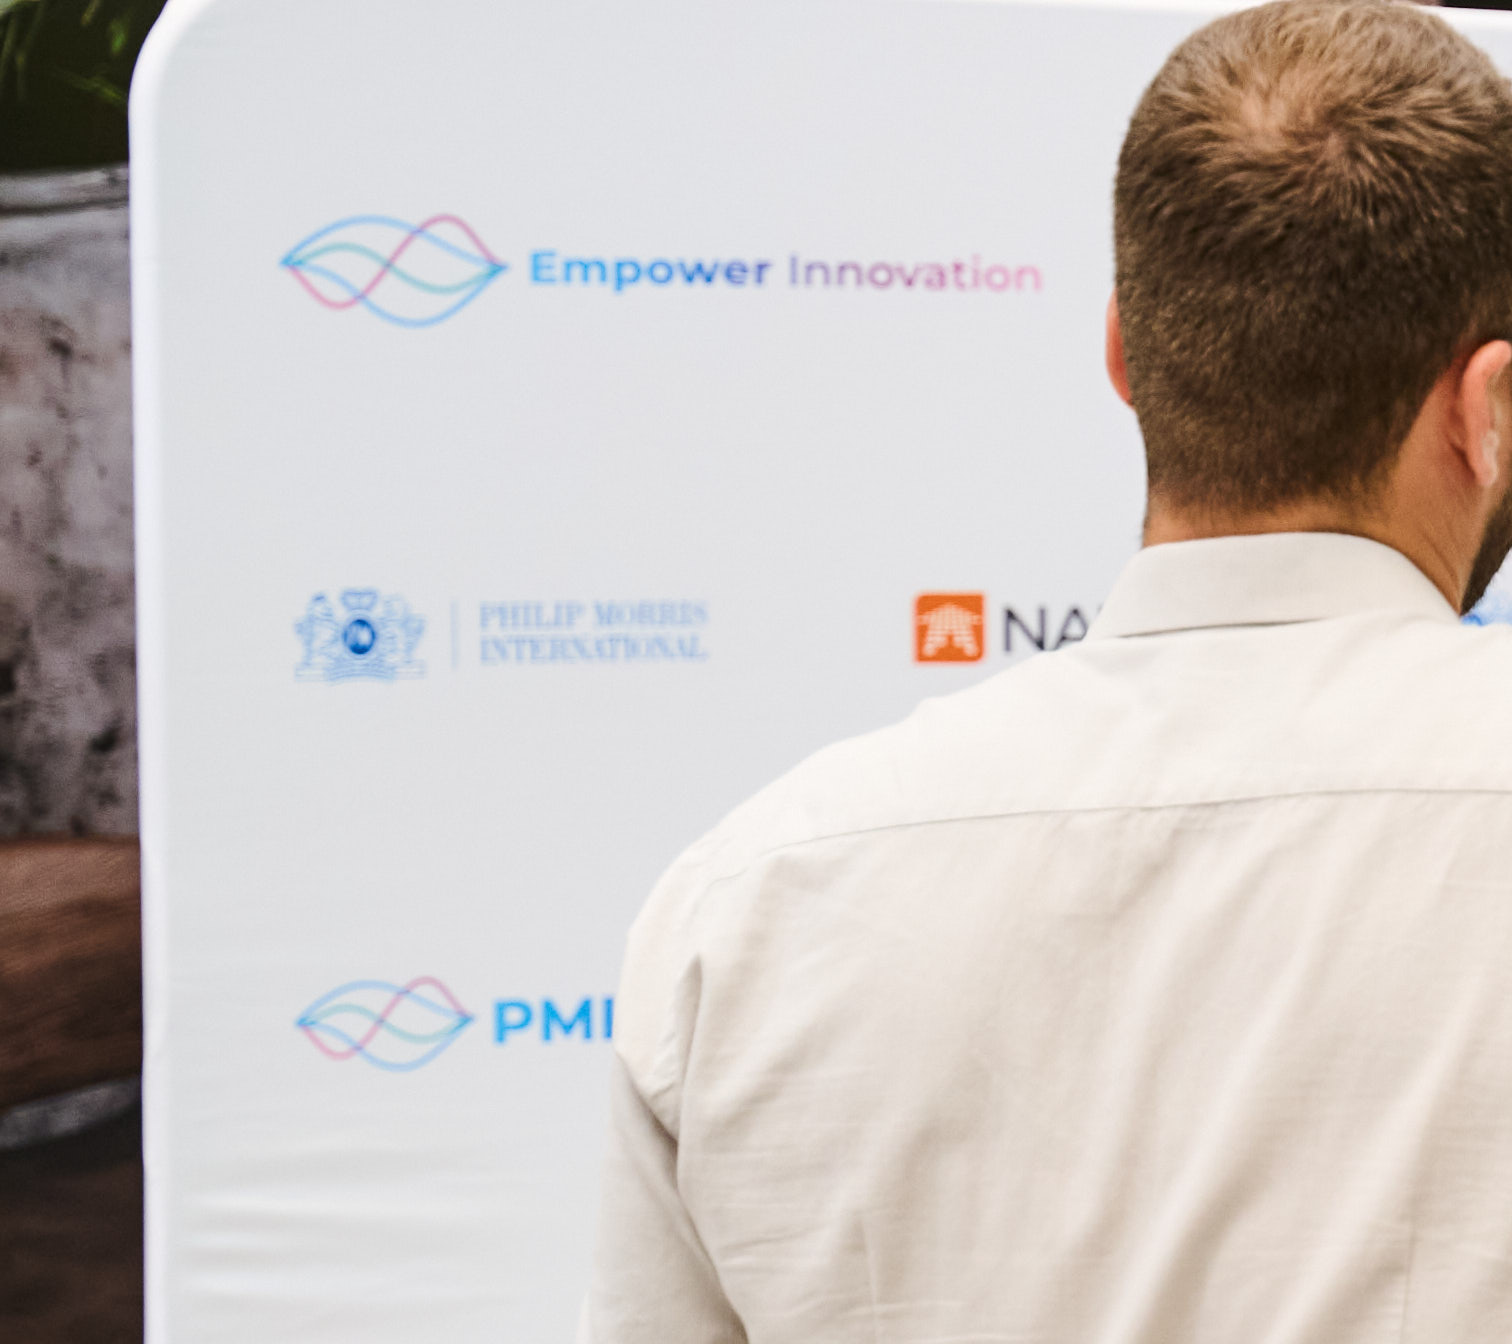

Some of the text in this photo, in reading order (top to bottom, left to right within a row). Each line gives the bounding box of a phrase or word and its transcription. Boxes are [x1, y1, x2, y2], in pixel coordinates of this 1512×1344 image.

[530, 250, 1043, 294] Empower Innovation
[480, 600, 709, 630] PHILIP MORRIS
[480, 633, 709, 664] INTERNATIONAL
